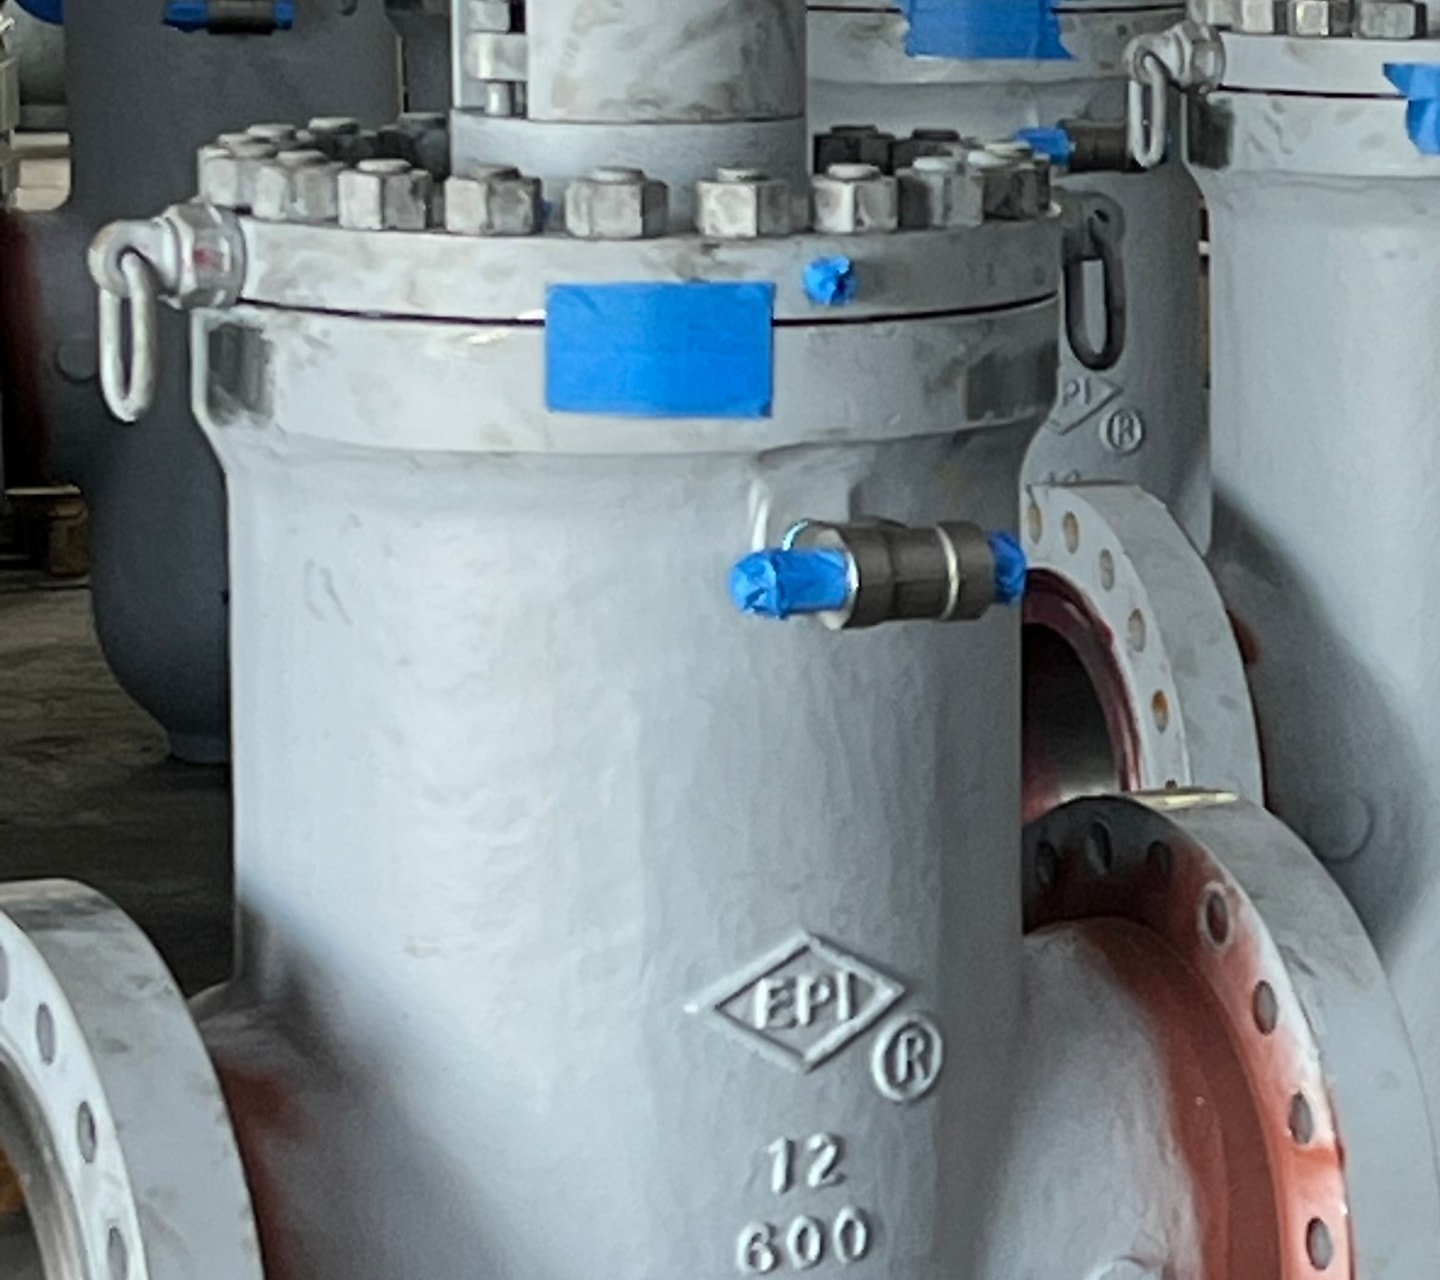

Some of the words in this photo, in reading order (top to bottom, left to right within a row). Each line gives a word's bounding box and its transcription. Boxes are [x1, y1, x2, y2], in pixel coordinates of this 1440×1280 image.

[755, 970, 860, 1030] EPI
[766, 1133, 847, 1195] 12
[735, 1205, 872, 1275] 600
